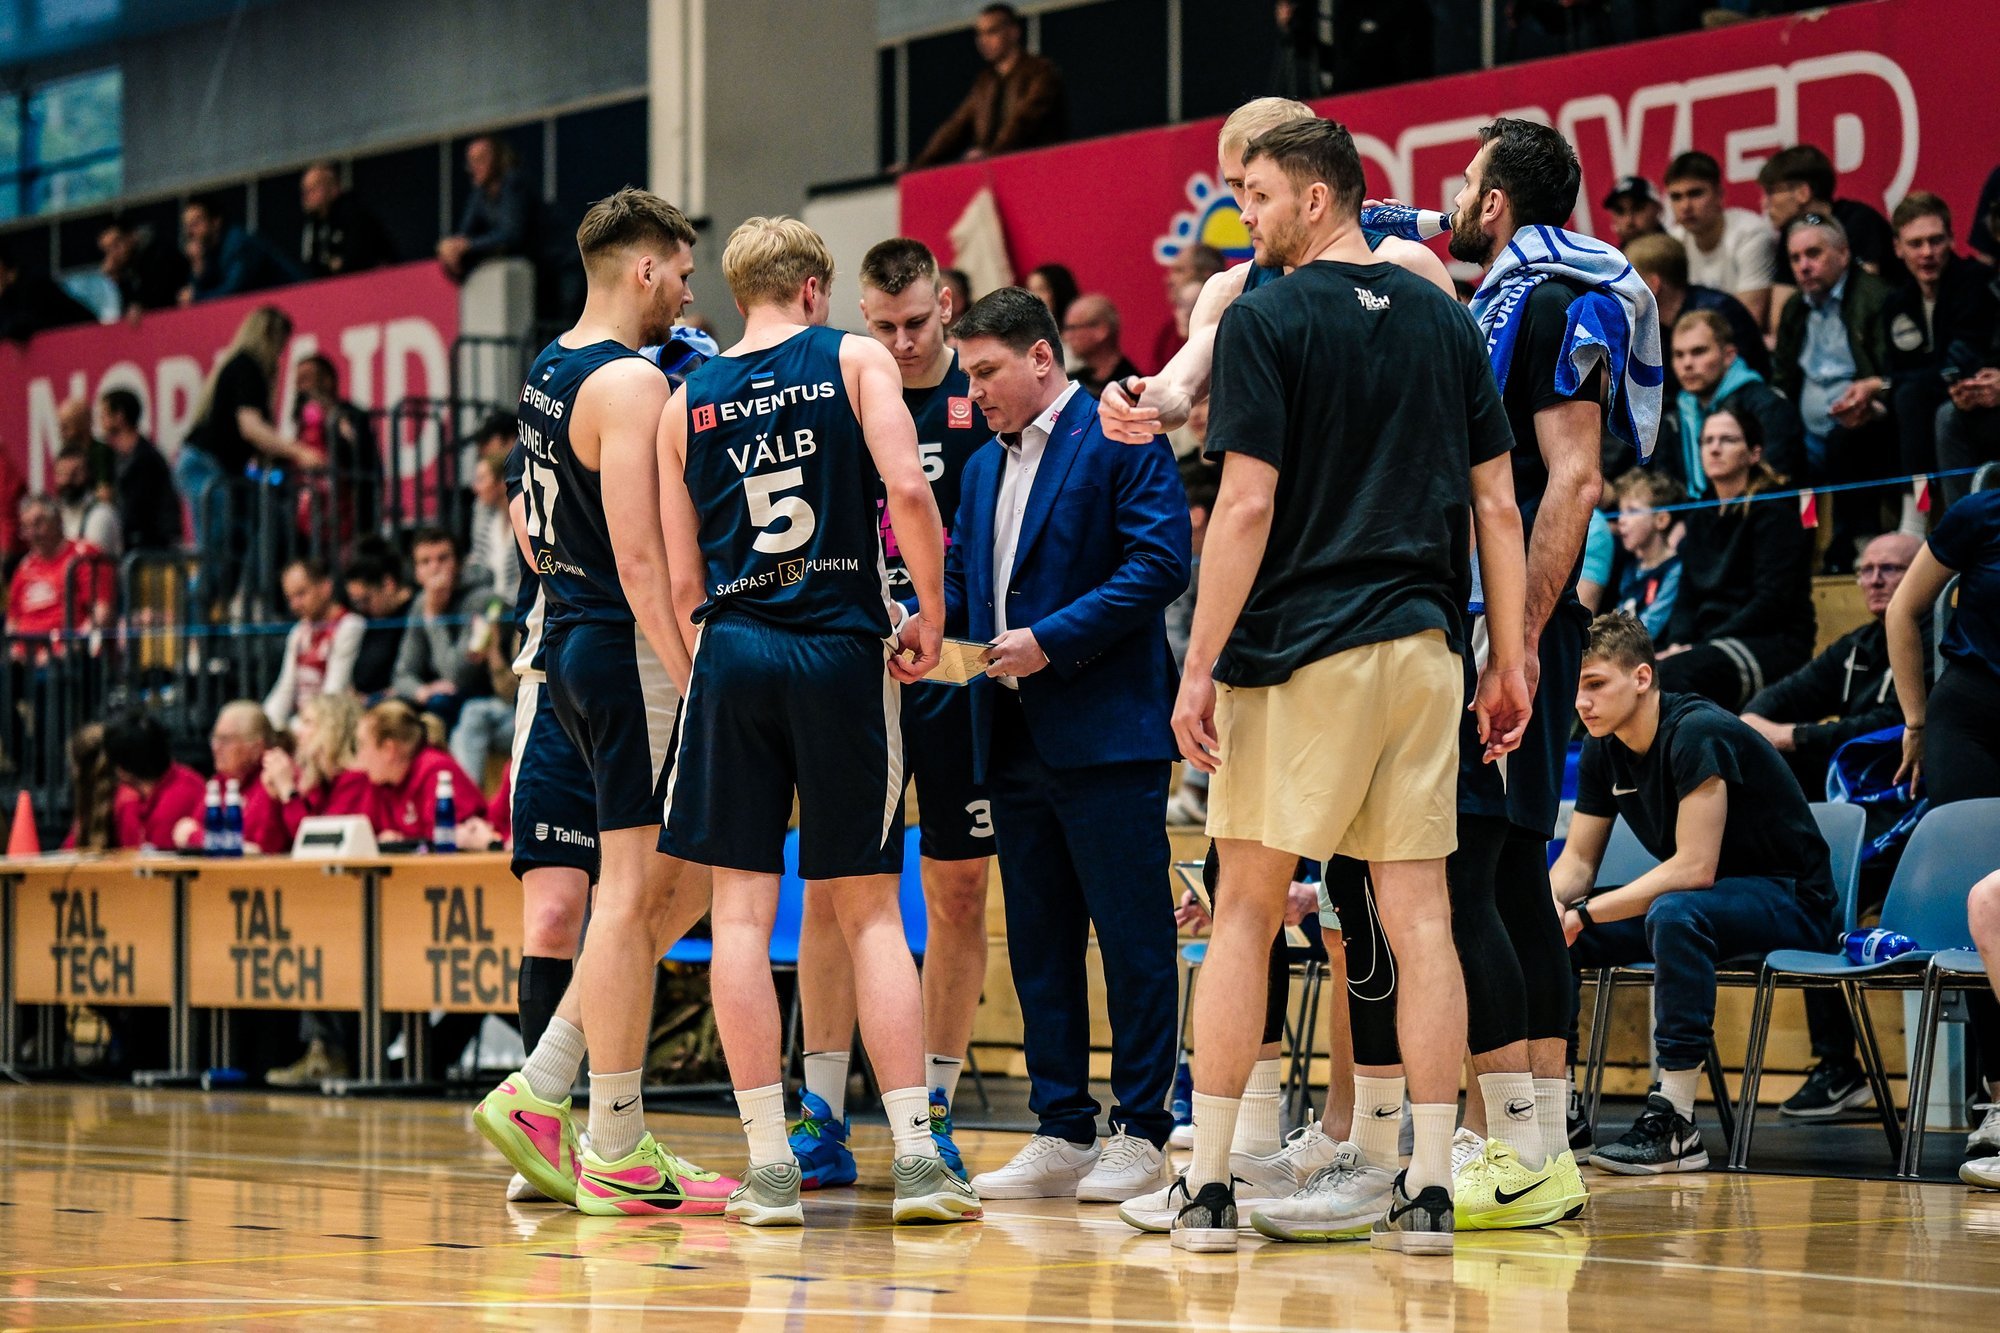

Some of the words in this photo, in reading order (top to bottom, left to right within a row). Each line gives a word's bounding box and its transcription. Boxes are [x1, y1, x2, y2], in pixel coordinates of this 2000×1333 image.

[523, 384, 565, 419] EVENTUS
[720, 381, 836, 422] EVENTUS
[727, 428, 817, 473] VÄLB
[521, 455, 560, 546] 17
[743, 466, 816, 554] 5
[715, 571, 776, 597] SKEPAST
[805, 558, 859, 573] PUHKIM
[553, 826, 595, 849] Tallinn
[50, 888, 107, 942] TAL
[228, 887, 292, 942] TAL
[424, 886, 494, 943] TAL
[50, 944, 136, 996] TECH
[229, 946, 324, 1001] TECH
